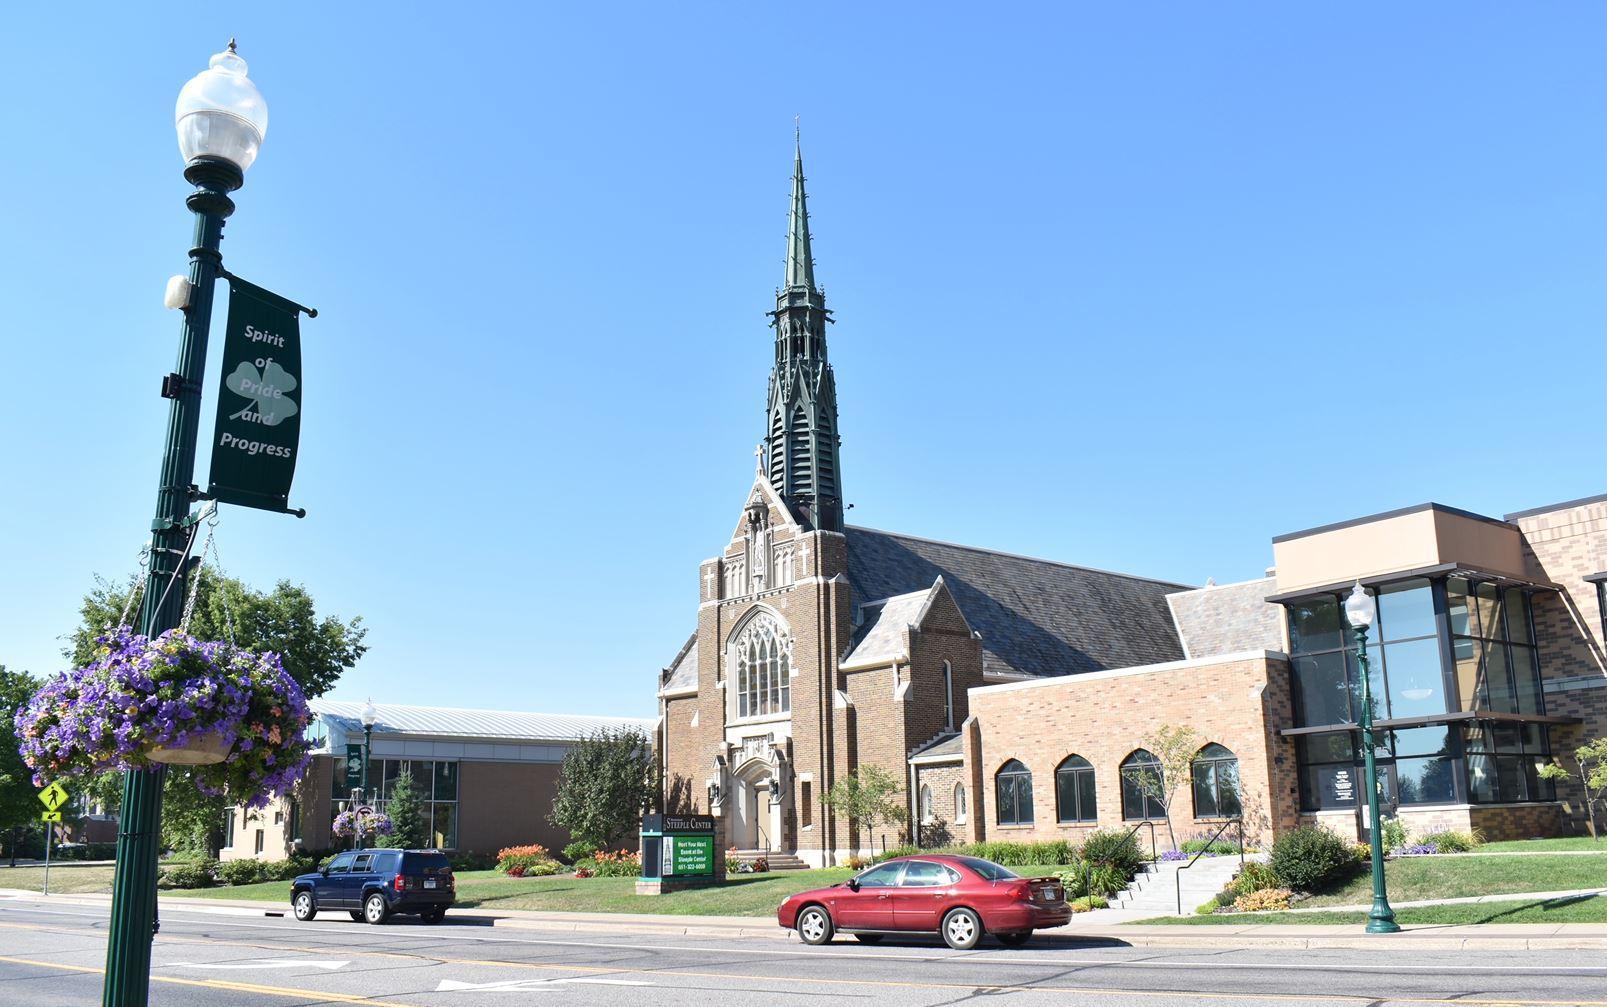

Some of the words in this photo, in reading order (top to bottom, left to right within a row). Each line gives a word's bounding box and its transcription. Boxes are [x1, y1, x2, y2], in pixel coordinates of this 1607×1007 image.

[244, 325, 285, 348] Spirit
[255, 357, 273, 370] of
[239, 378, 282, 400] Pride
[241, 408, 274, 426] and
[220, 432, 291, 458] Progress
[666, 818, 689, 829] STEEPLE
[690, 818, 712, 829] CENTER
